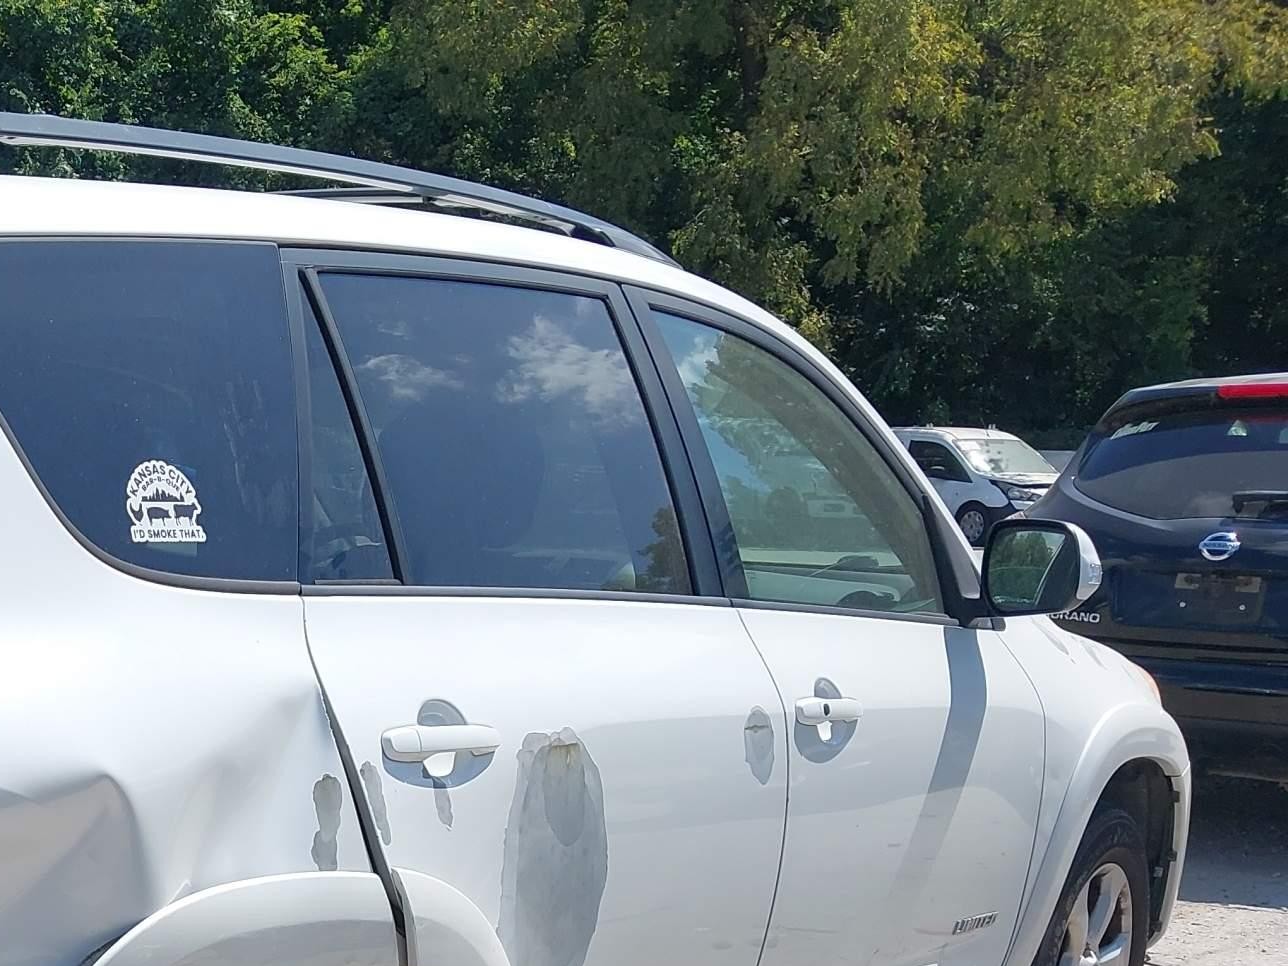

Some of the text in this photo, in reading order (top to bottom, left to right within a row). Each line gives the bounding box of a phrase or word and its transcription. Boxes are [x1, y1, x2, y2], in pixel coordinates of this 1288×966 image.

[130, 463, 193, 497] KANSAS CITY
[133, 529, 146, 539] I'D
[147, 529, 178, 539] SMOKE
[1046, 611, 1101, 623] URANO
